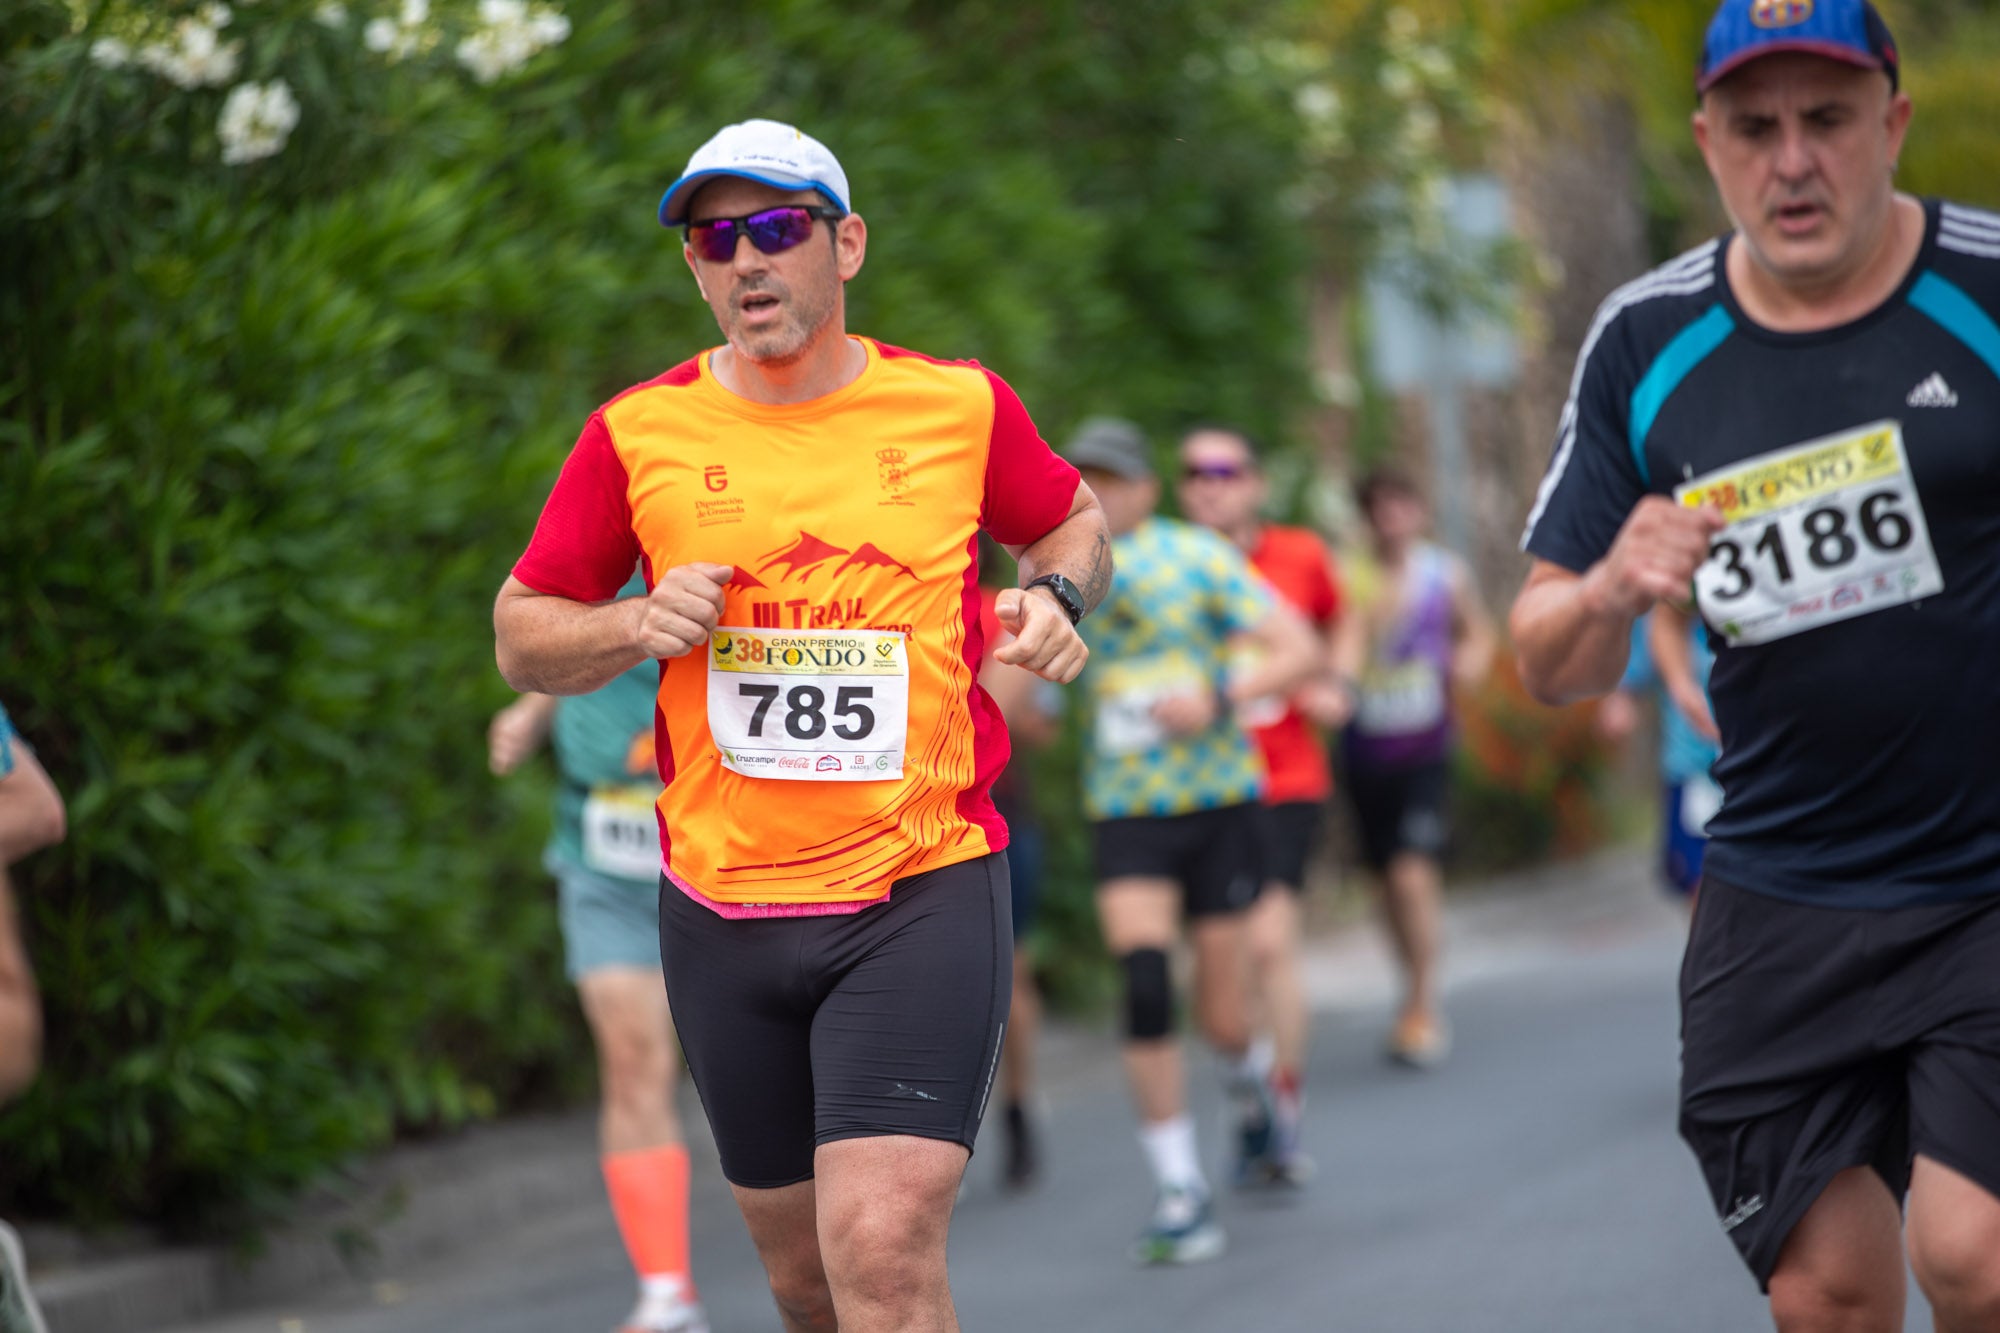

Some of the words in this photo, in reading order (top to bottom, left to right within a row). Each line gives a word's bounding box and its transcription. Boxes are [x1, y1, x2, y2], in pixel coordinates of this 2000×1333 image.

[707, 506, 745, 517] Granada
[1709, 489, 1913, 600] 3186
[736, 637, 765, 663] 38
[771, 638, 807, 647] GRAN
[810, 638, 857, 648] PREMIO
[766, 647, 866, 667] FONDO
[738, 682, 876, 741] 785
[736, 754, 776, 764] Cruzcampo
